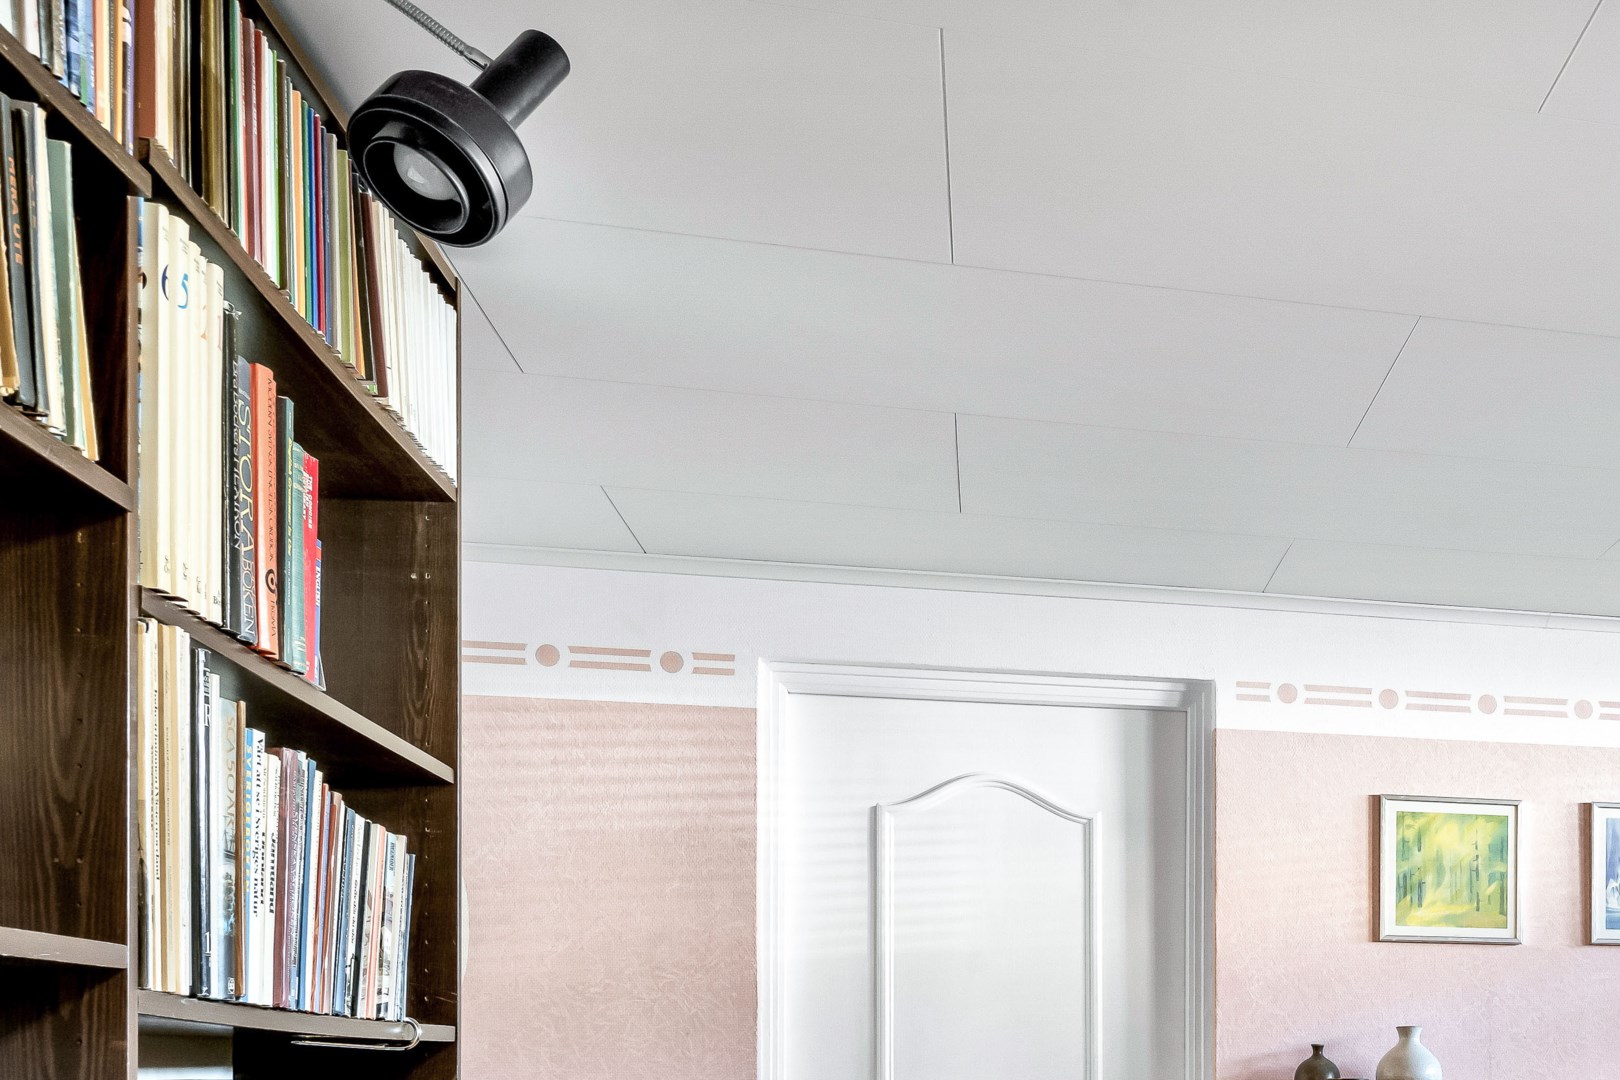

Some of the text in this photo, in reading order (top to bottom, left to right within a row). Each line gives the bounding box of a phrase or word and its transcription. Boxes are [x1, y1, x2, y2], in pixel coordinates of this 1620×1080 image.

[8, 157, 24, 266] MERA UTE
[178, 273, 189, 310] 5
[238, 400, 254, 559] STORA
[226, 716, 237, 756] SCA
[225, 759, 236, 785] 50
[256, 768, 264, 789] att
[245, 745, 254, 894] SVERIGEBOKEN
[255, 792, 262, 807] se
[251, 818, 264, 875] Sveriges
[253, 877, 262, 918] natur
